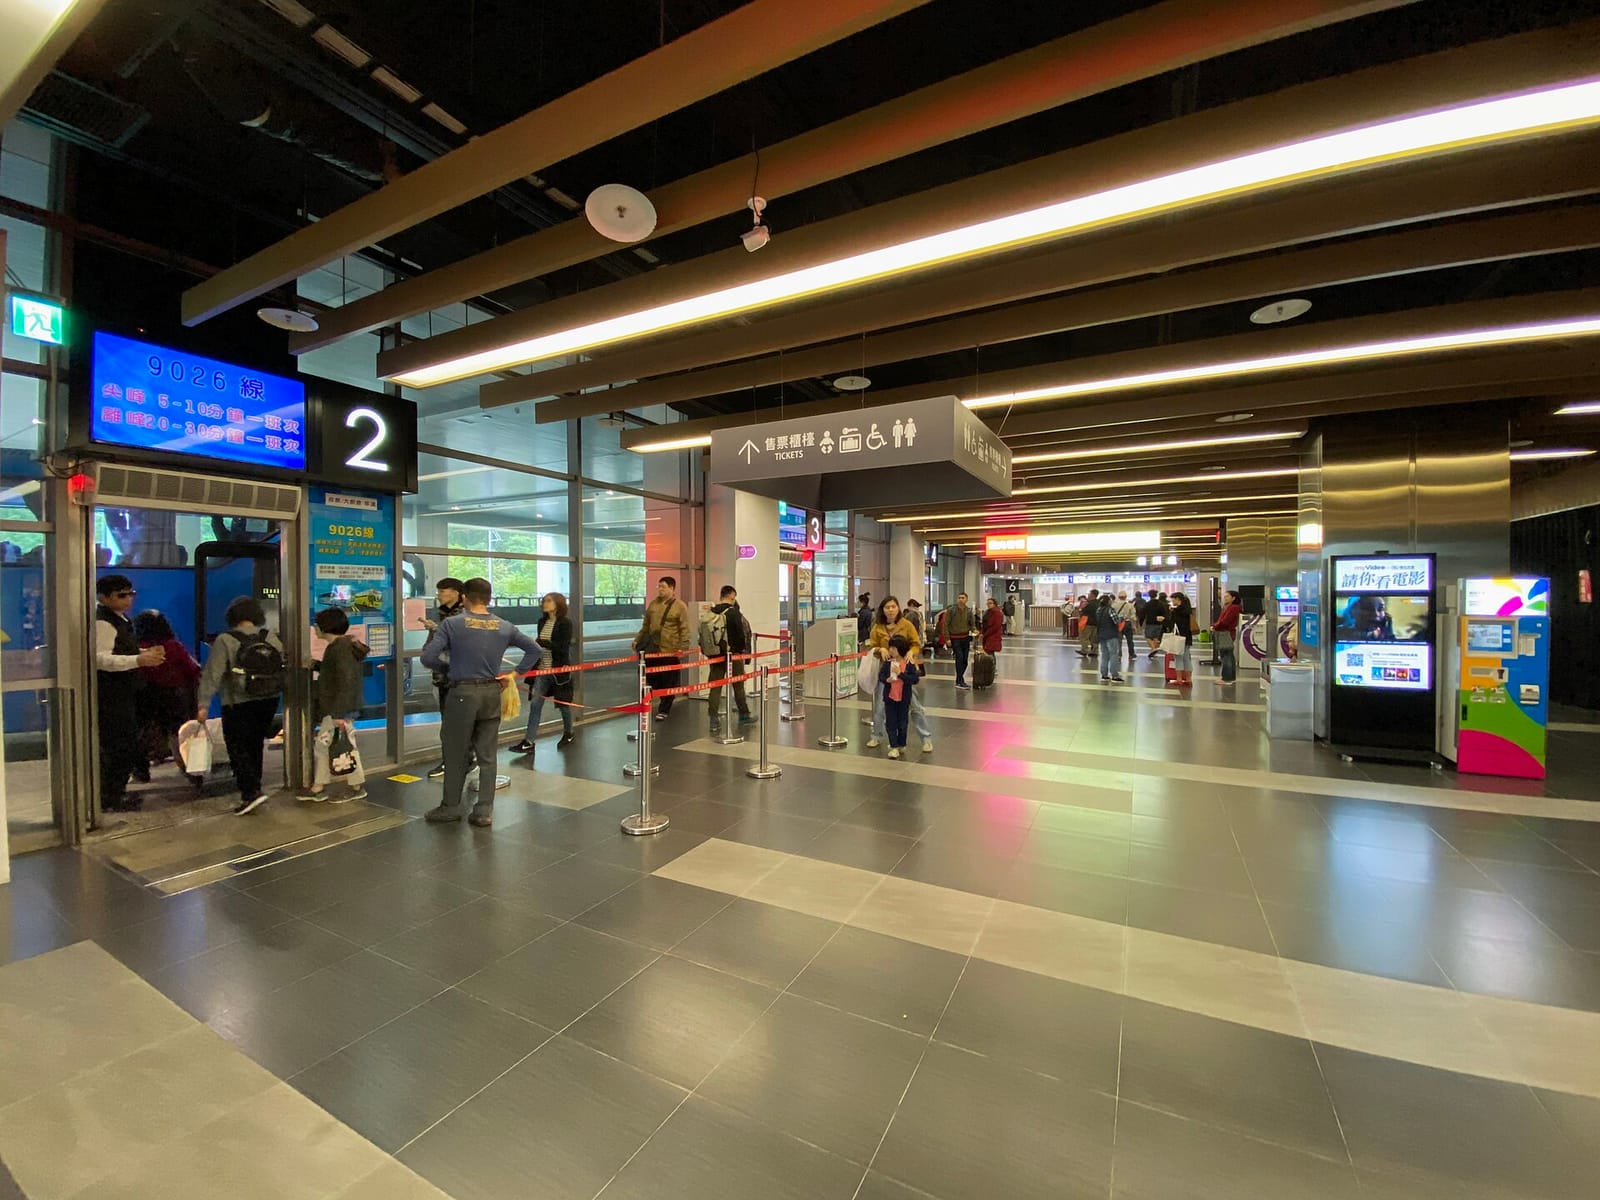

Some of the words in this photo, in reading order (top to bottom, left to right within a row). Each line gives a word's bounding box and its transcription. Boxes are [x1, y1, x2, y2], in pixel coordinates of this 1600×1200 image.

[239, 376, 265, 401] 線
[345, 408, 389, 472] 2
[774, 450, 804, 461] TICKETS
[811, 517, 820, 544] 3
[1008, 581, 1017, 592] 6
